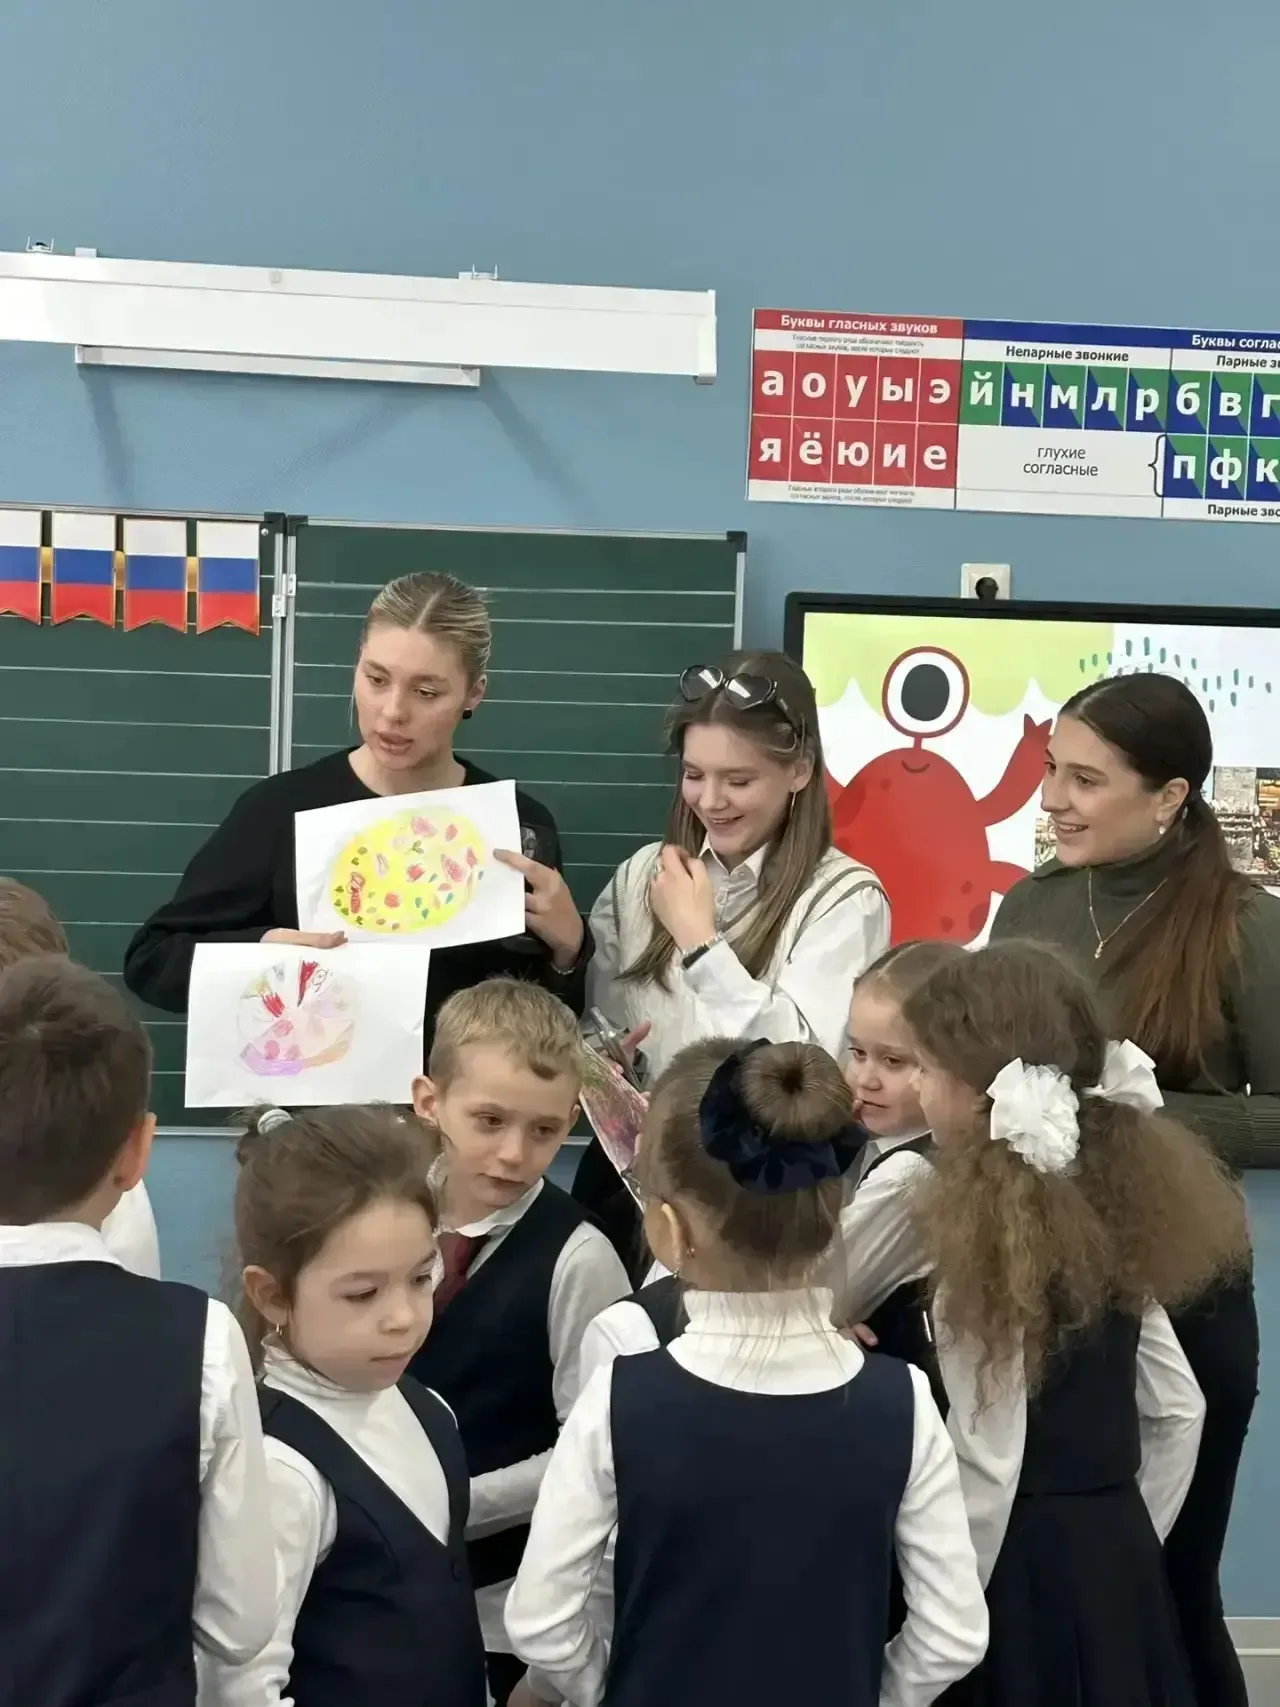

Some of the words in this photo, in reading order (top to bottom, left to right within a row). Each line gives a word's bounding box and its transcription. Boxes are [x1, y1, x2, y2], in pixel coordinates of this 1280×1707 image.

[781, 315, 824, 330] Буквы
[829, 319, 887, 332] гласных
[890, 322, 938, 335] звуков
[1192, 334, 1235, 348] Буквы
[1006, 346, 1073, 361] Непарные
[1075, 349, 1129, 362] звонкие
[1216, 355, 1267, 368] Парные
[761, 370, 784, 396] а
[802, 372, 826, 398] о
[845, 375, 868, 407] у
[882, 377, 913, 402] ы
[929, 378, 950, 404] э
[970, 371, 993, 406] й
[1011, 383, 1034, 407] н
[1050, 385, 1078, 410] м
[1091, 387, 1117, 411] л
[1136, 388, 1159, 420] р
[1176, 382, 1201, 415] б
[1219, 392, 1242, 416] в
[759, 437, 781, 462] я
[799, 432, 823, 465] ё
[837, 441, 869, 467] ю
[883, 444, 907, 468] и
[923, 445, 947, 470] е
[1038, 446, 1086, 460] глухие
[1023, 463, 1098, 477] согласные
[1173, 454, 1196, 479] п
[1210, 449, 1242, 488] ф
[1256, 458, 1279, 482] к
[1208, 504, 1257, 517] Парные
